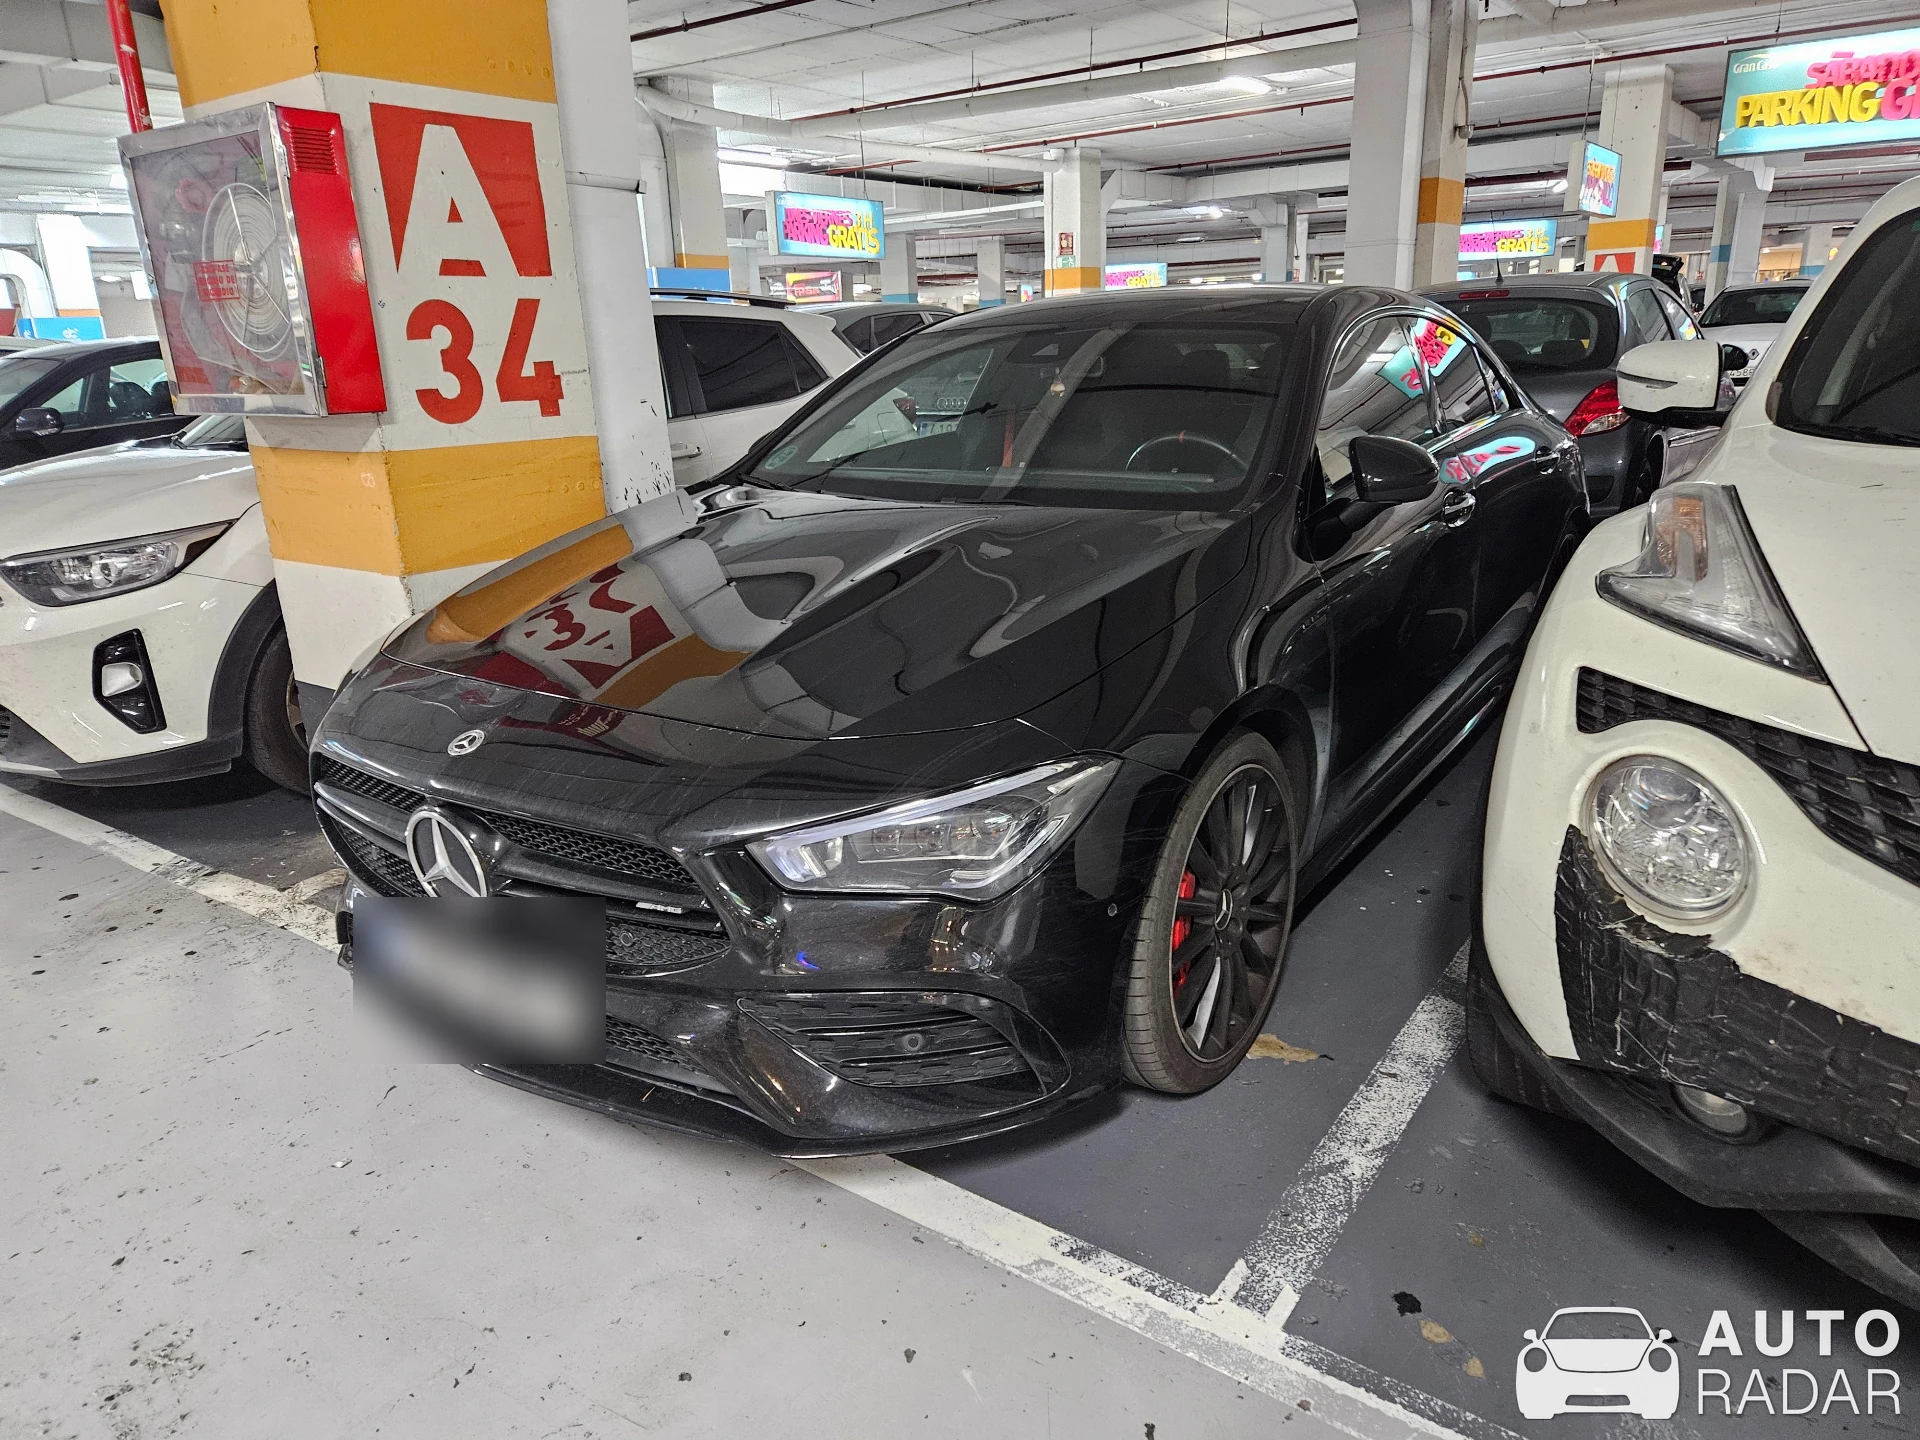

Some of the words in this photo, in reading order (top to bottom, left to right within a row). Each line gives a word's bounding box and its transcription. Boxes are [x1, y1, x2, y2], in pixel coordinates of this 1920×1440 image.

[1733, 62, 1756, 74] Gran
[1735, 82, 1881, 129] PARKING
[1880, 78, 1920, 121] G
[397, 123, 522, 278] A
[783, 220, 830, 247] PARKING
[828, 224, 880, 255] GRATIS
[1496, 235, 1550, 254] GRATIS
[405, 298, 565, 425] 34
